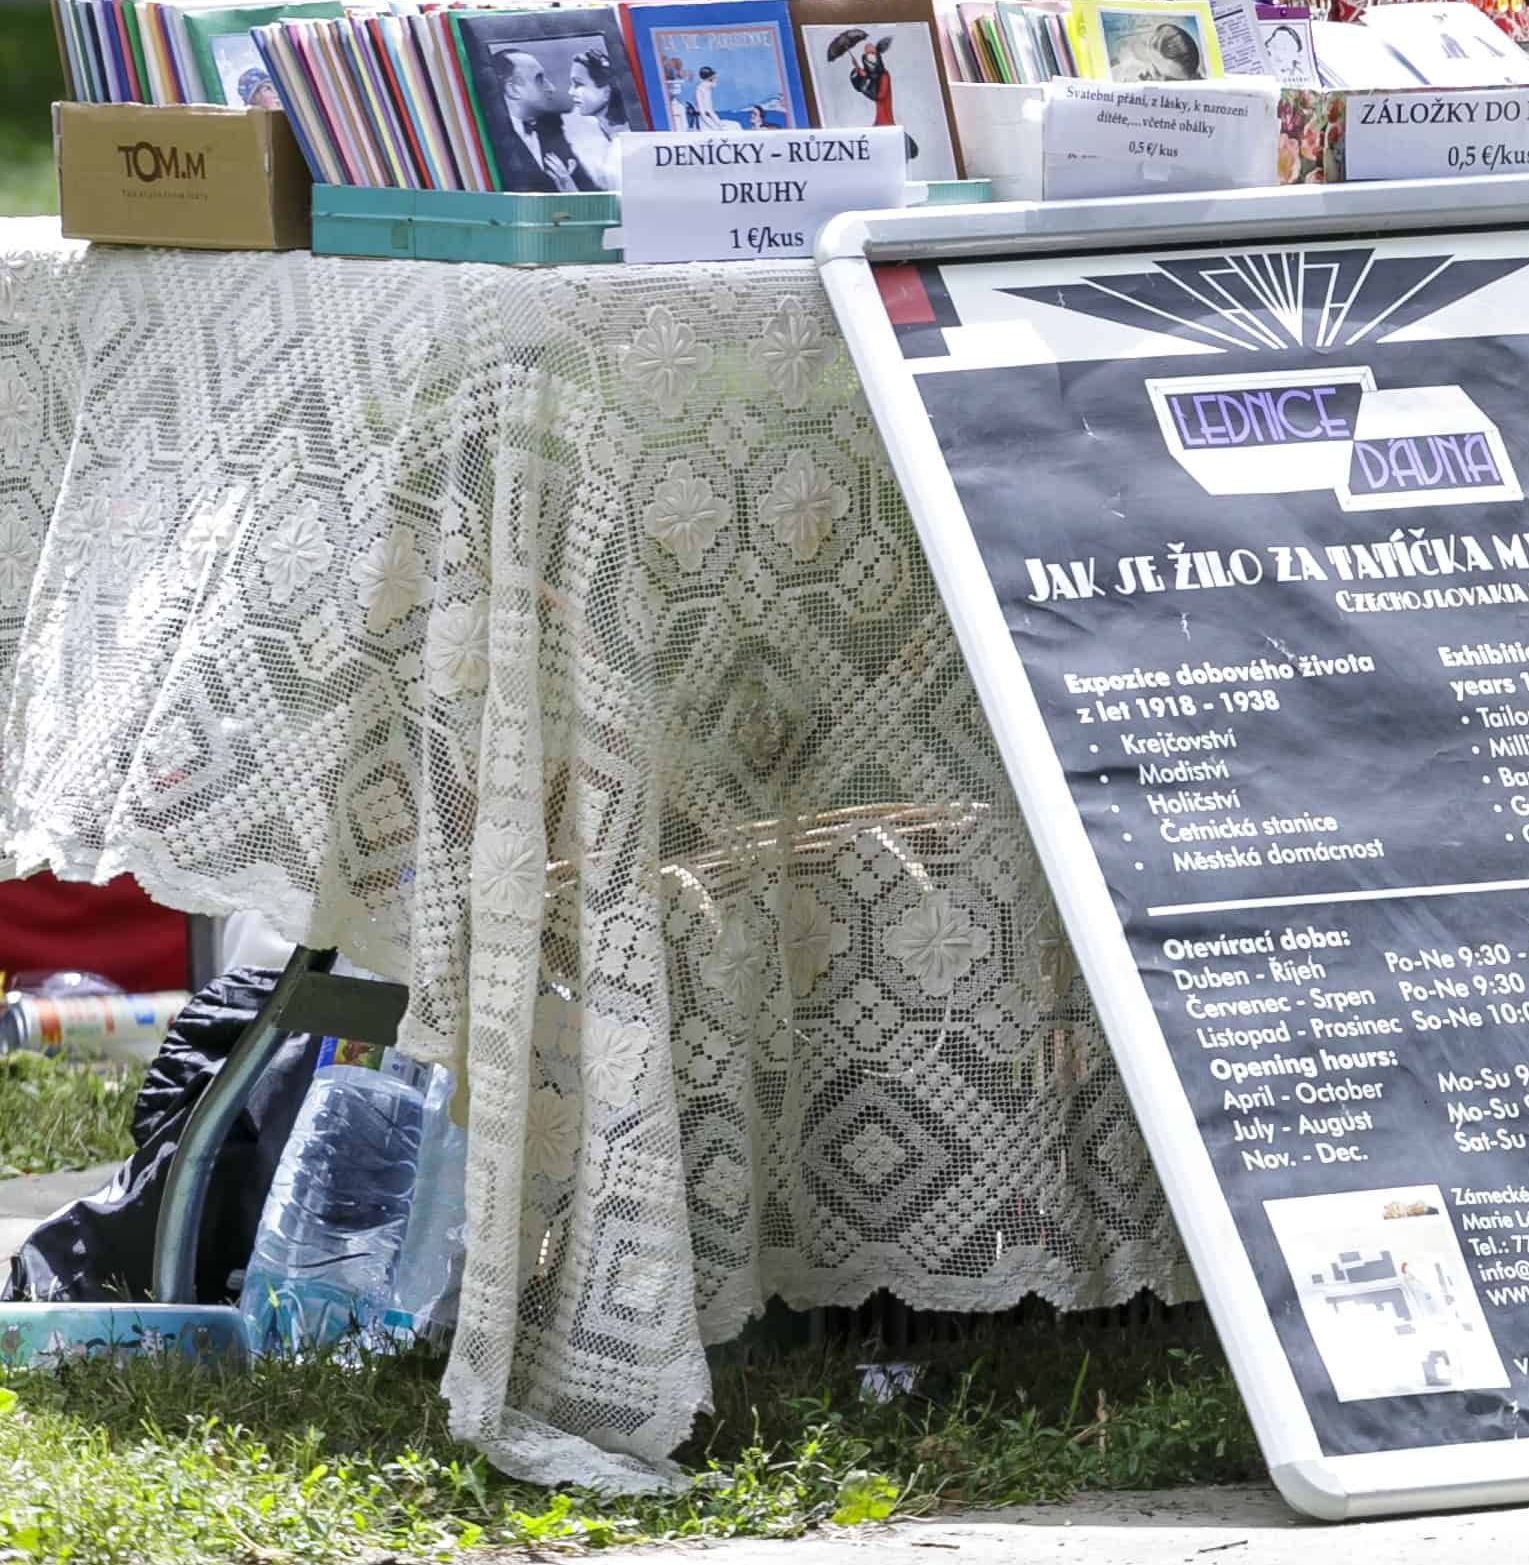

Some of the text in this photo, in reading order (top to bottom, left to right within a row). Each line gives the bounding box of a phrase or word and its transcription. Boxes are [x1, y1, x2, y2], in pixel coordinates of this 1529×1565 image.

[1117, 93, 1149, 108] přání,
[1151, 99, 1158, 107] z
[1160, 95, 1191, 113] lásky,
[1361, 98, 1479, 125] ZÁLOŽKY
[1486, 100, 1520, 122] DO
[1179, 120, 1215, 138] obálky
[117, 141, 206, 183] TOM.M
[654, 135, 870, 167] DENÍČKY RŮZNÉ
[1129, 141, 1145, 155] 0,5
[1159, 143, 1178, 157] kus
[1448, 146, 1476, 170] 0,5
[720, 180, 808, 204] DRUHY
[730, 226, 804, 253] 1 €/kus
[1171, 387, 1350, 447] LEDNICE
[1024, 557, 1106, 603] JAK
[1114, 555, 1165, 595] SE
[1167, 542, 1263, 591] ŽILO
[1268, 546, 1327, 582] ZA
[1324, 528, 1493, 581] TATÍČKA
[1334, 581, 1529, 613] CZECHOSLOVAKIA
[1064, 654, 1375, 696] Expozice dobového života
[1450, 676, 1516, 701] years
[1077, 689, 1280, 724] z let 1918 1938
[1120, 728, 1237, 757] Krejčovství
[1138, 760, 1230, 785] Modiství
[1147, 789, 1241, 815] Holičství
[1160, 812, 1338, 843] Četnická stanice
[1172, 838, 1384, 873] Městská domácnost
[1163, 927, 1351, 960] Otevírací doba:
[1173, 967, 1250, 990] Duben
[1268, 956, 1327, 985] Říjen
[1384, 948, 1455, 972] Po-Ne
[1458, 944, 1511, 967] 9:30
[1186, 994, 1291, 1019] Červenec
[1309, 988, 1376, 1012] Srpen
[1399, 978, 1469, 1002] Po-Ne
[1473, 972, 1525, 996] 9:30
[1197, 1020, 1291, 1049] Listopad
[1310, 1015, 1402, 1039] Prosinec
[1412, 1006, 1483, 1031] So-Ne
[1210, 1048, 1399, 1084] Opening hours:
[1223, 1085, 1276, 1114] April
[1295, 1078, 1384, 1104] October
[1438, 1067, 1511, 1092] Mo-Su
[1234, 1117, 1275, 1144] July
[1298, 1110, 1374, 1138] August
[1447, 1098, 1520, 1123] Mo-Su
[1241, 1149, 1297, 1171] Nov.
[1315, 1142, 1369, 1164] Dec.
[1455, 1129, 1526, 1152] Sat-Su
[1461, 1212, 1513, 1231] Marie
[1468, 1238, 1509, 1257] Tel.:
